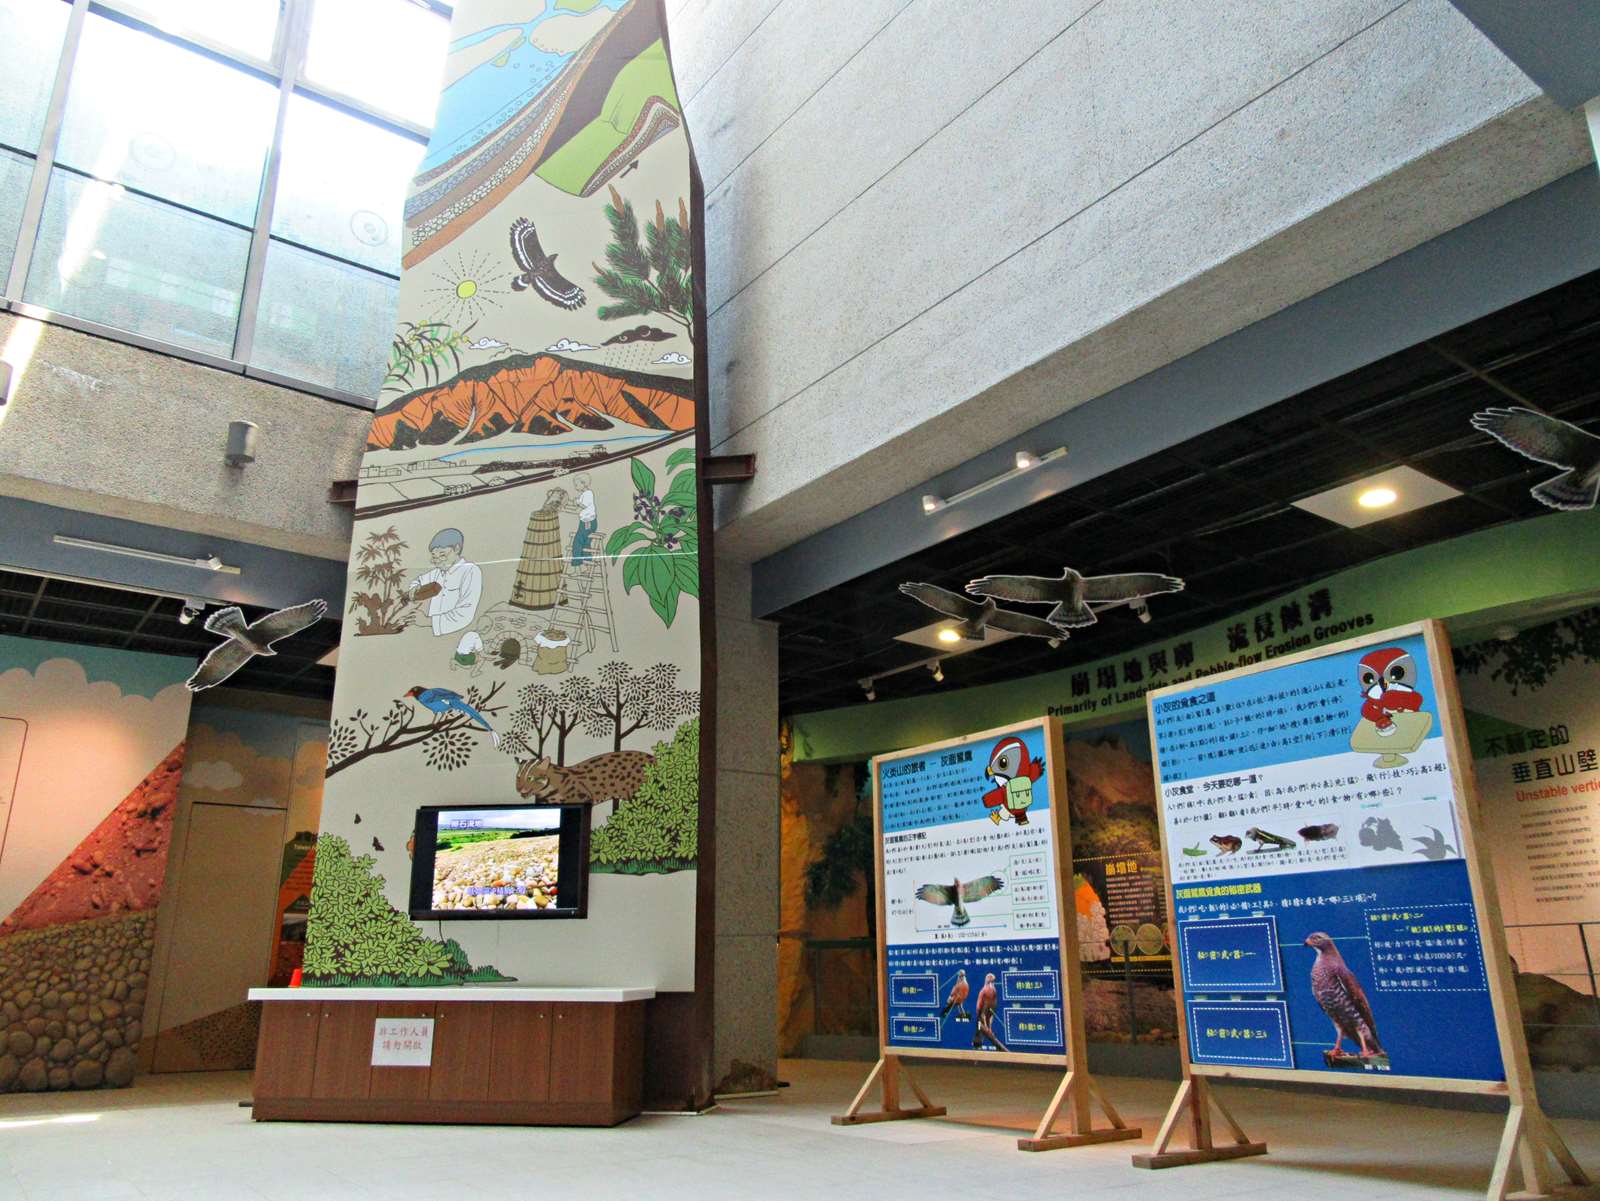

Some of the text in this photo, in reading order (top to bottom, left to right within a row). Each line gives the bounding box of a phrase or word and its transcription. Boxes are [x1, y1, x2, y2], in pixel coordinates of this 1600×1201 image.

[1047, 699, 1098, 717] Primarily
[1101, 692, 1113, 707] of
[1265, 632, 1311, 659] Erosion
[1314, 613, 1374, 641] Grooves
[1511, 748, 1600, 784] 垂直山壁
[1515, 785, 1568, 802] Unstable
[379, 1024, 428, 1038] 非工作人員
